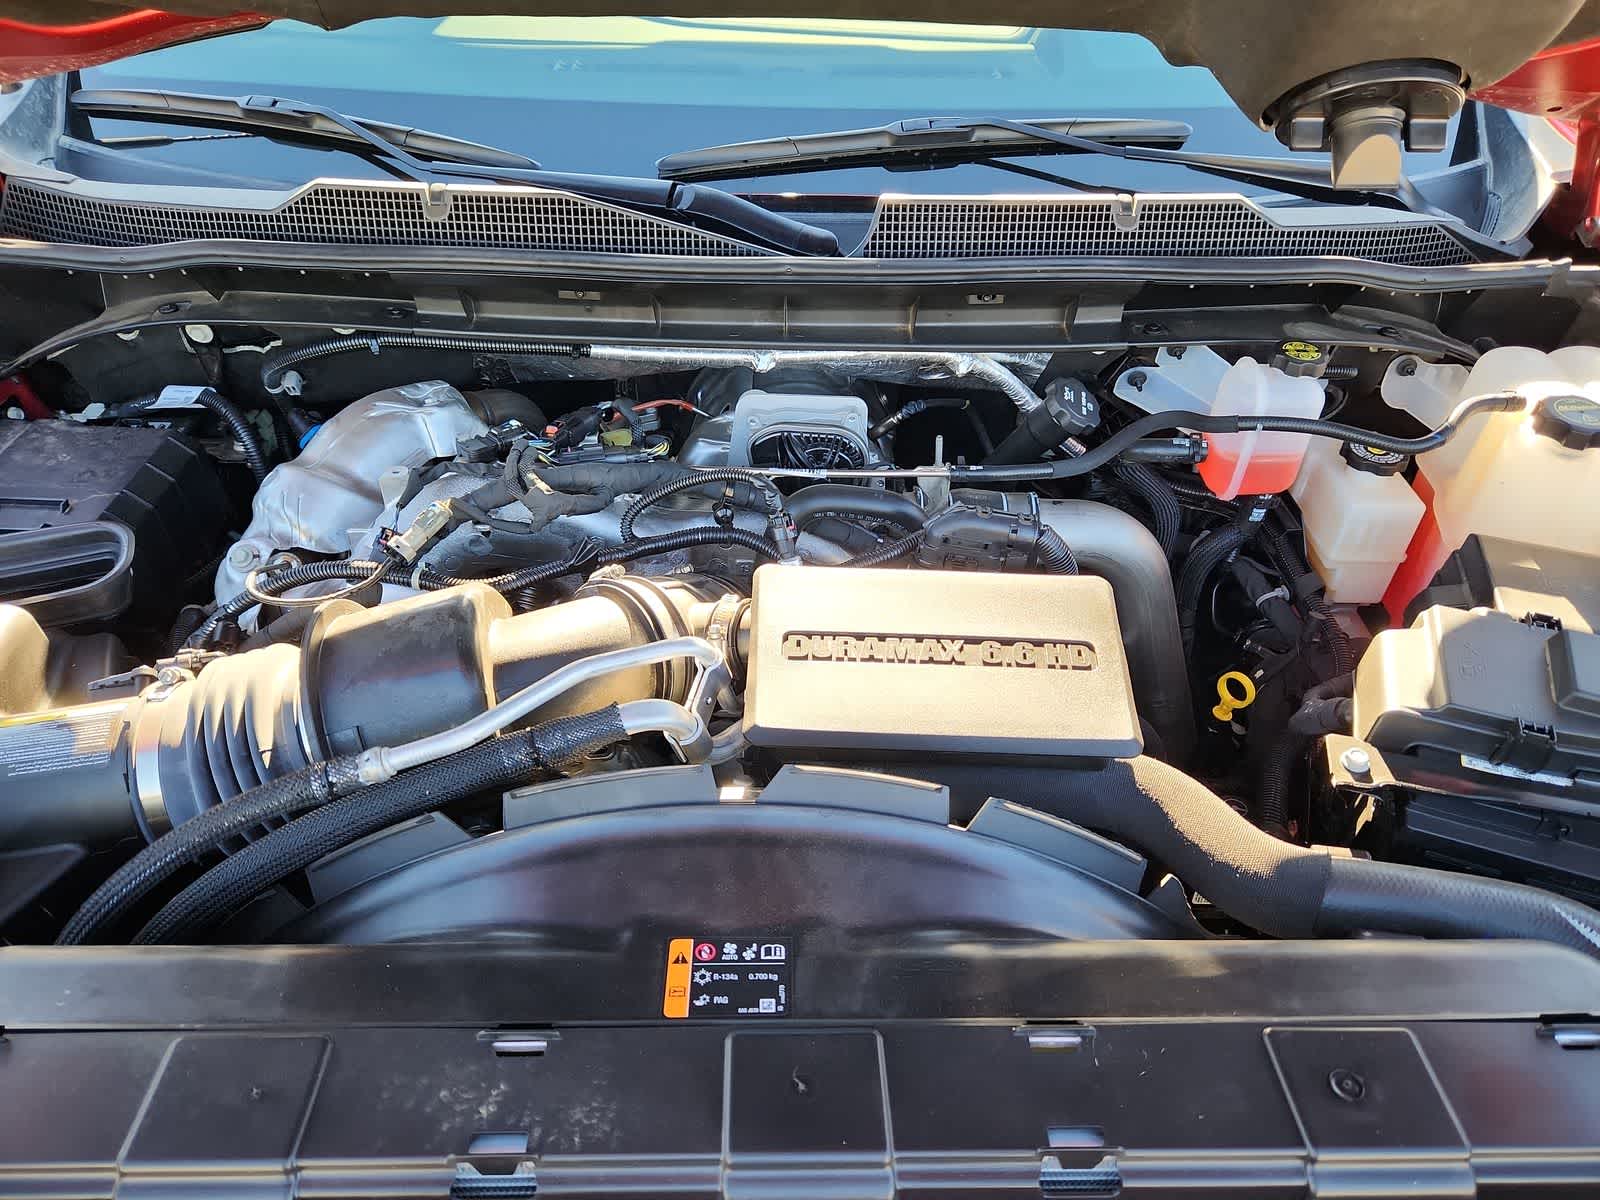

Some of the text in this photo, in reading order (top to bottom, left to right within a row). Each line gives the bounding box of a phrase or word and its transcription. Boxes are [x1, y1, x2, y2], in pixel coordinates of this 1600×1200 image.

[784, 634, 1094, 669] DURAMAX 6.6 HD
[713, 996, 729, 1004] PAG
